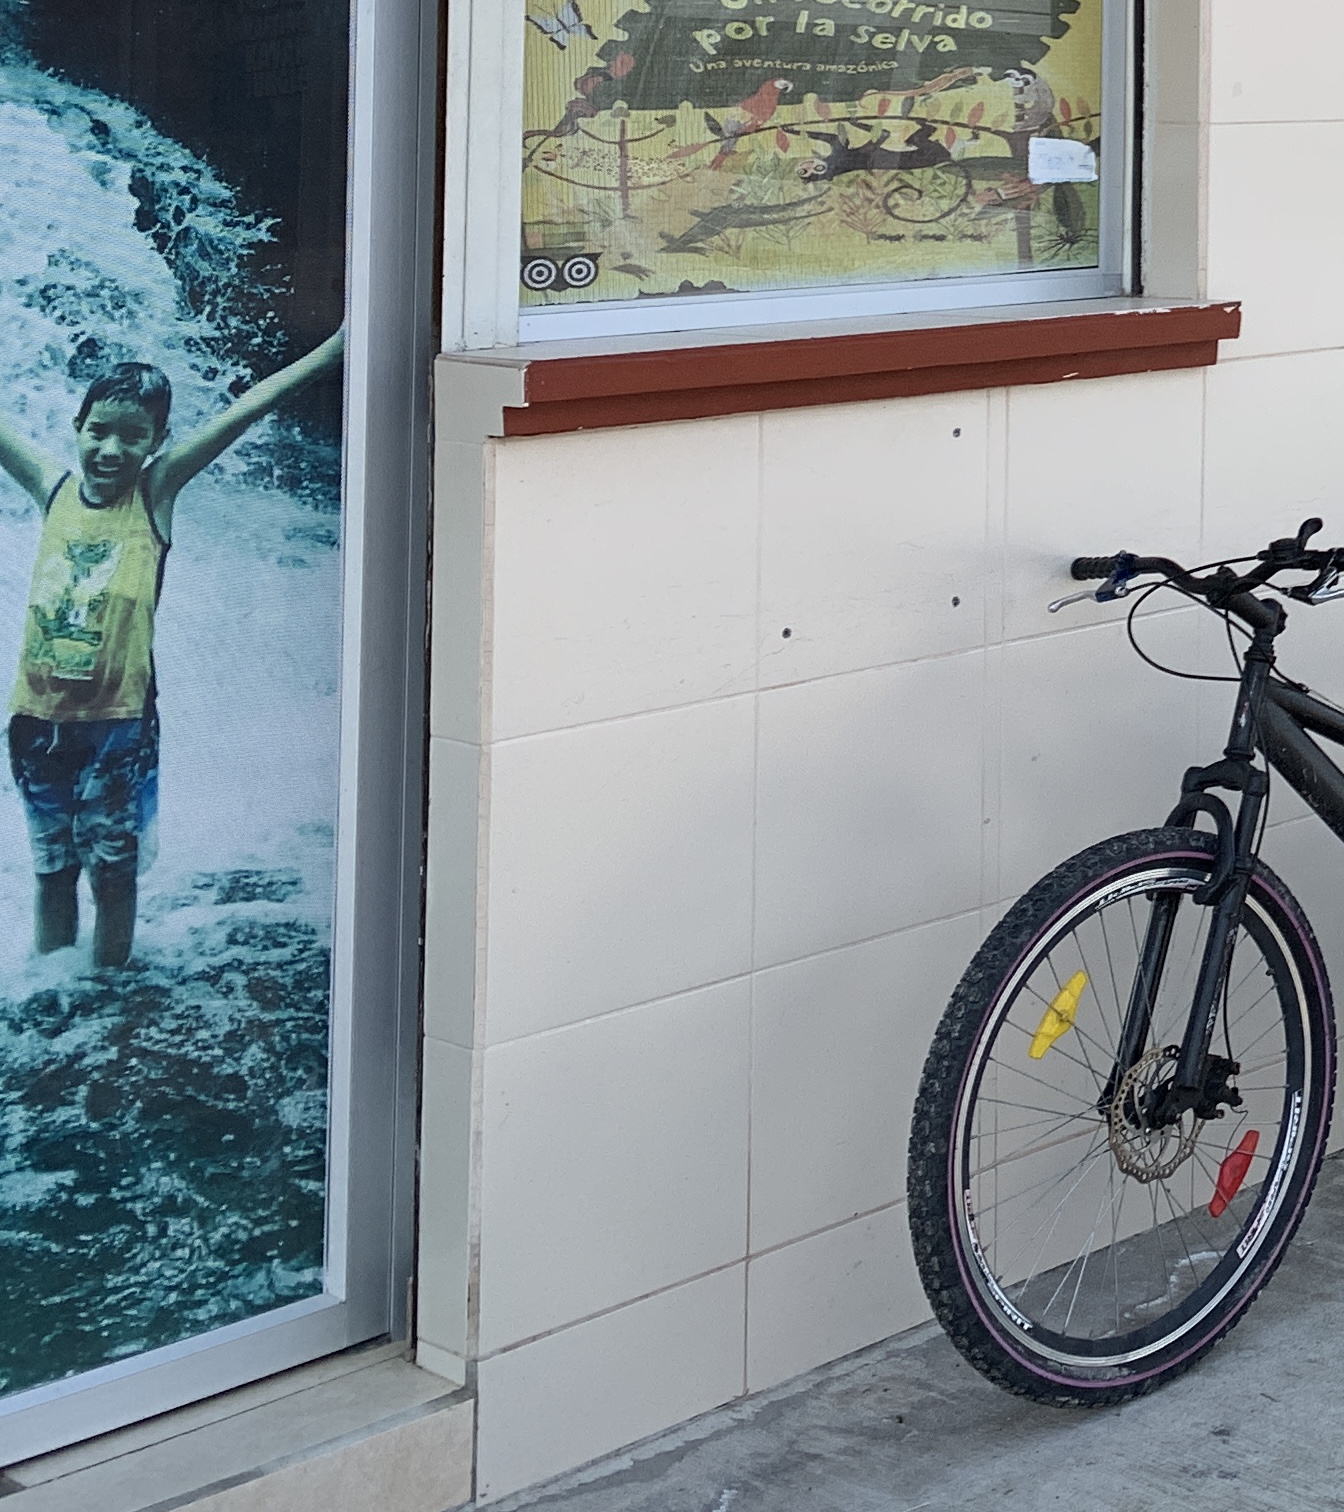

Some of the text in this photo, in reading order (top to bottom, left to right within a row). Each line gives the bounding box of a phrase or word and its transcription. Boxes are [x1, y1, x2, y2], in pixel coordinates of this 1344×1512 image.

[692, 15, 774, 54] por
[796, 11, 835, 37] la
[688, 57, 899, 75] Una aventura amazónica
